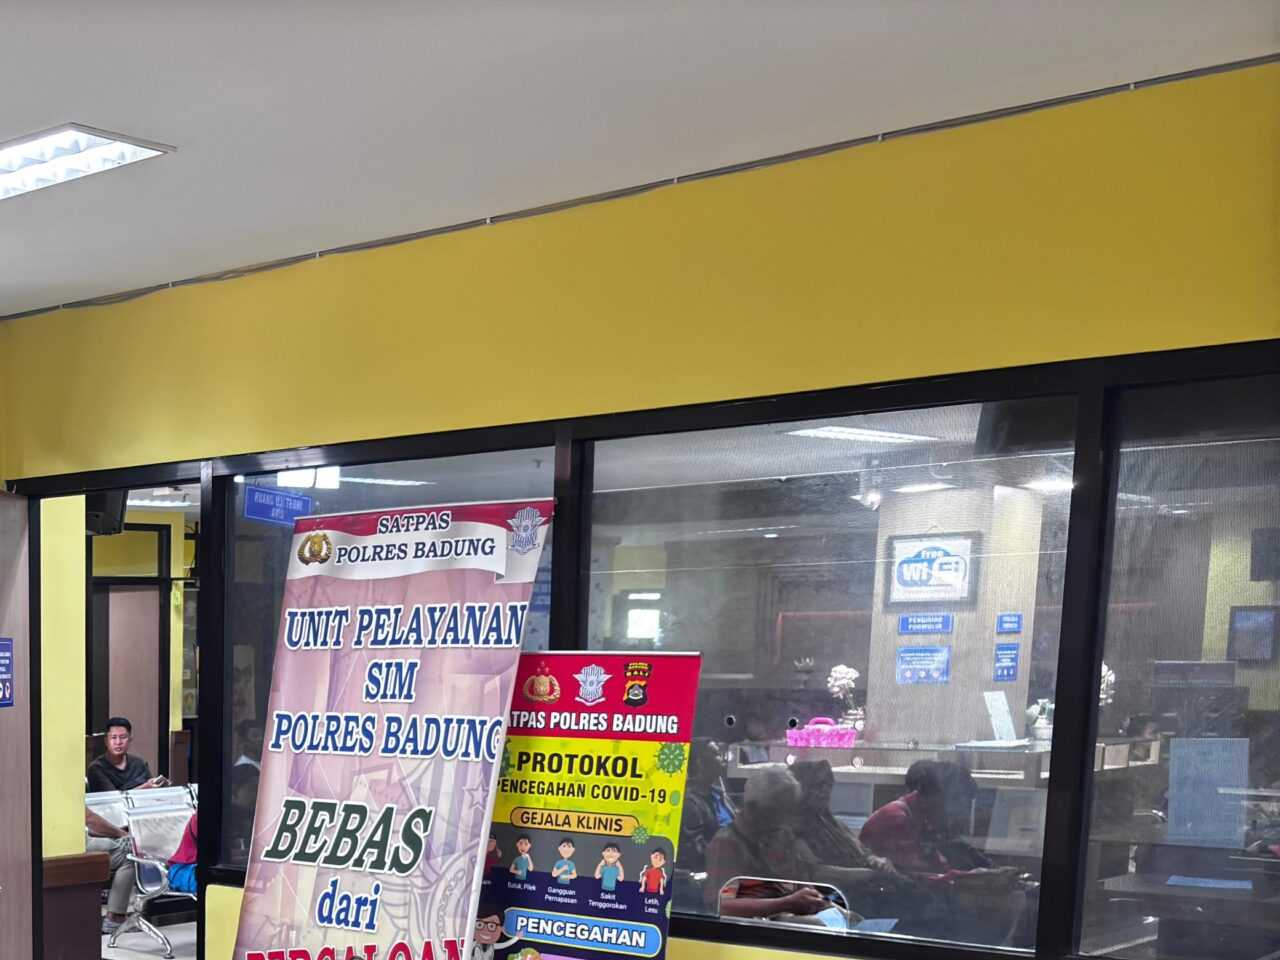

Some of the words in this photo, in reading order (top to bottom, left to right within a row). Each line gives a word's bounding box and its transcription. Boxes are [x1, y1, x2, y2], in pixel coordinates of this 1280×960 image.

[378, 512, 450, 534] SATPAS
[336, 542, 408, 563] POLRES
[413, 538, 496, 559] BADUNG
[285, 609, 349, 648] UNIT
[353, 604, 528, 647] PELAYANAN
[364, 661, 418, 701] SIM
[550, 712, 607, 732] POLRES
[612, 715, 679, 734] BADUNG
[270, 714, 376, 753] POLRES
[380, 716, 503, 762] BADUNG
[517, 751, 643, 779] PROTOKOL
[591, 784, 667, 803] COVID-19
[520, 810, 570, 829] GEJALA
[577, 813, 623, 832] KLINIS
[263, 798, 433, 876] BEBAS
[547, 886, 576, 896] Gangguan
[600, 892, 617, 901] Sakit
[317, 877, 381, 932] dari
[588, 899, 627, 911] Tenggorokan
[516, 916, 646, 947] PENCEGAHAN
